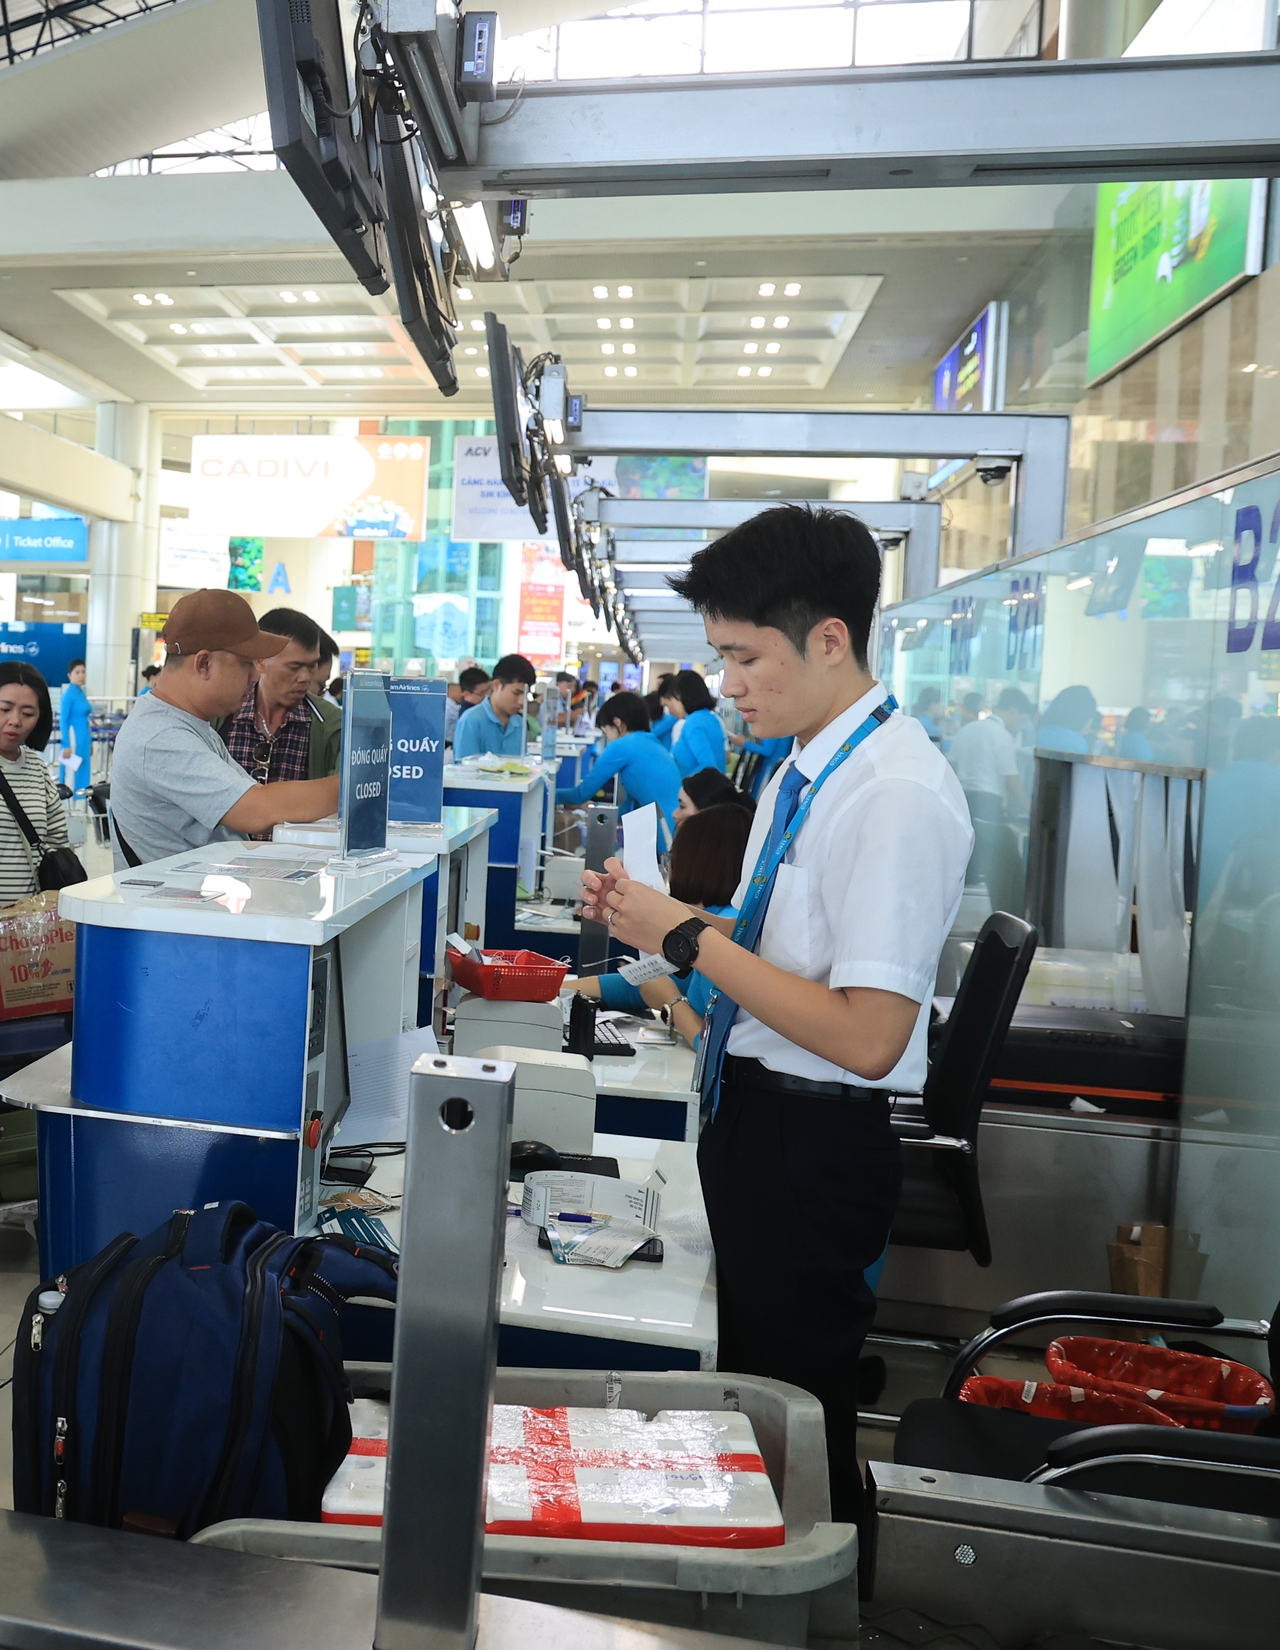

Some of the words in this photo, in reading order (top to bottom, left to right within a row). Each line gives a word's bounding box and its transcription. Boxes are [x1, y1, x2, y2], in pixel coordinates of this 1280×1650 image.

[465, 446, 492, 456] ACV
[200, 458, 330, 478] CADIVI
[13, 536, 42, 548] Ticket
[44, 536, 74, 549] Office
[267, 562, 292, 594] A
[397, 736, 439, 753] QUẦY
[351, 749, 370, 766] ĐÓNG
[371, 744, 388, 764] QUẦY
[389, 766, 424, 779] SED
[356, 783, 381, 799] CLOSED
